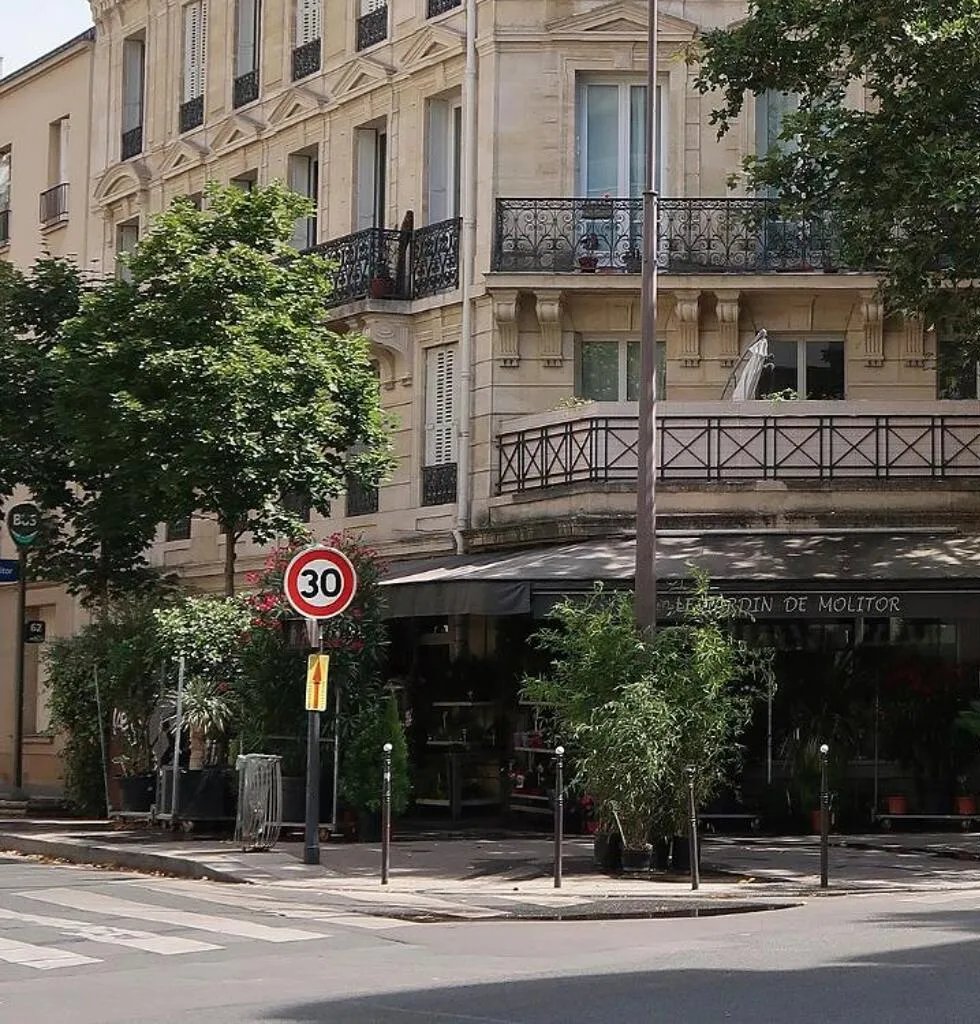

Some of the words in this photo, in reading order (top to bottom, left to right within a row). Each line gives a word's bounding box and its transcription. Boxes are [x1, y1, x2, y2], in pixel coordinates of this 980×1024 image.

[13, 514, 37, 526] BUS
[300, 568, 342, 599] 30
[784, 596, 808, 613] DE
[818, 596, 901, 613] MOLITOR
